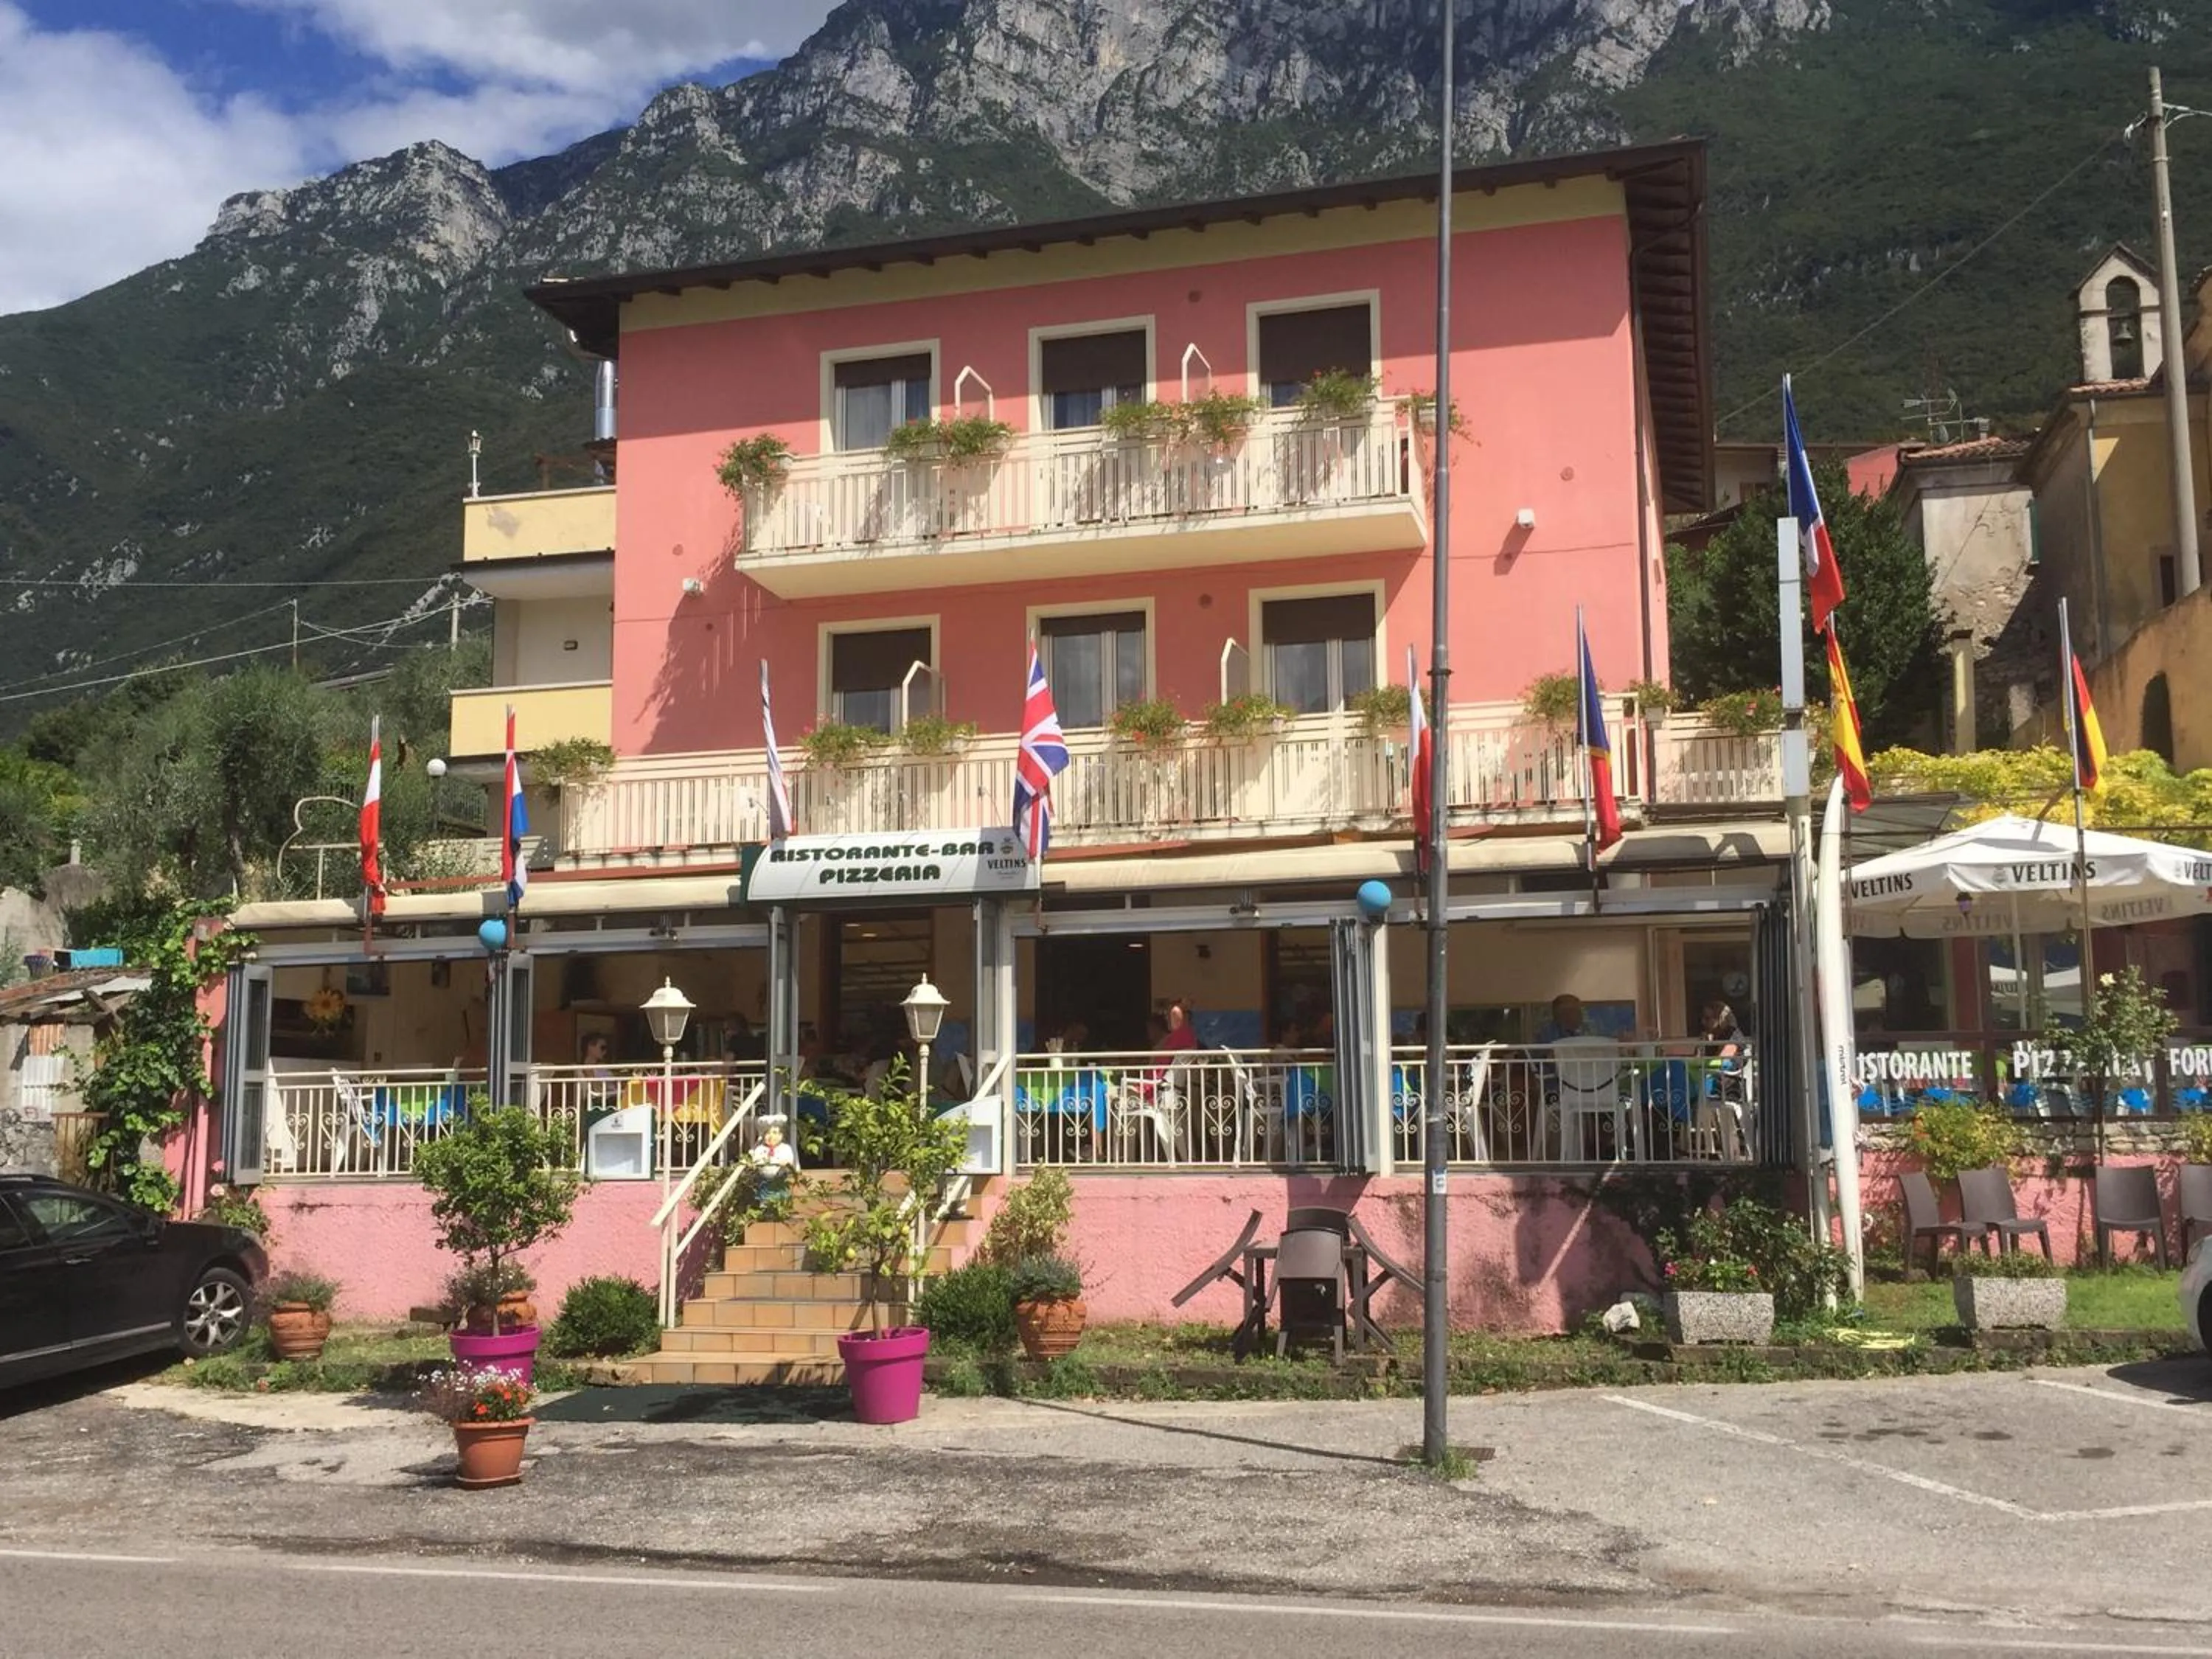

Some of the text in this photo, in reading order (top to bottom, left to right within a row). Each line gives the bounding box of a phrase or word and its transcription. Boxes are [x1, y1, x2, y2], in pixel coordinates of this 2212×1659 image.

[770, 841, 994, 863] RISTORANTE-BAR
[819, 864, 941, 885] PIZZERIA
[987, 858, 1026, 870] VELTINS
[2011, 861, 2096, 883] VELTINS
[2184, 860, 2212, 880] VELT
[1851, 873, 1913, 899] VELTINS
[1857, 1051, 1974, 1080] ISTORANTE
[2169, 1047, 2212, 1077] FOR
